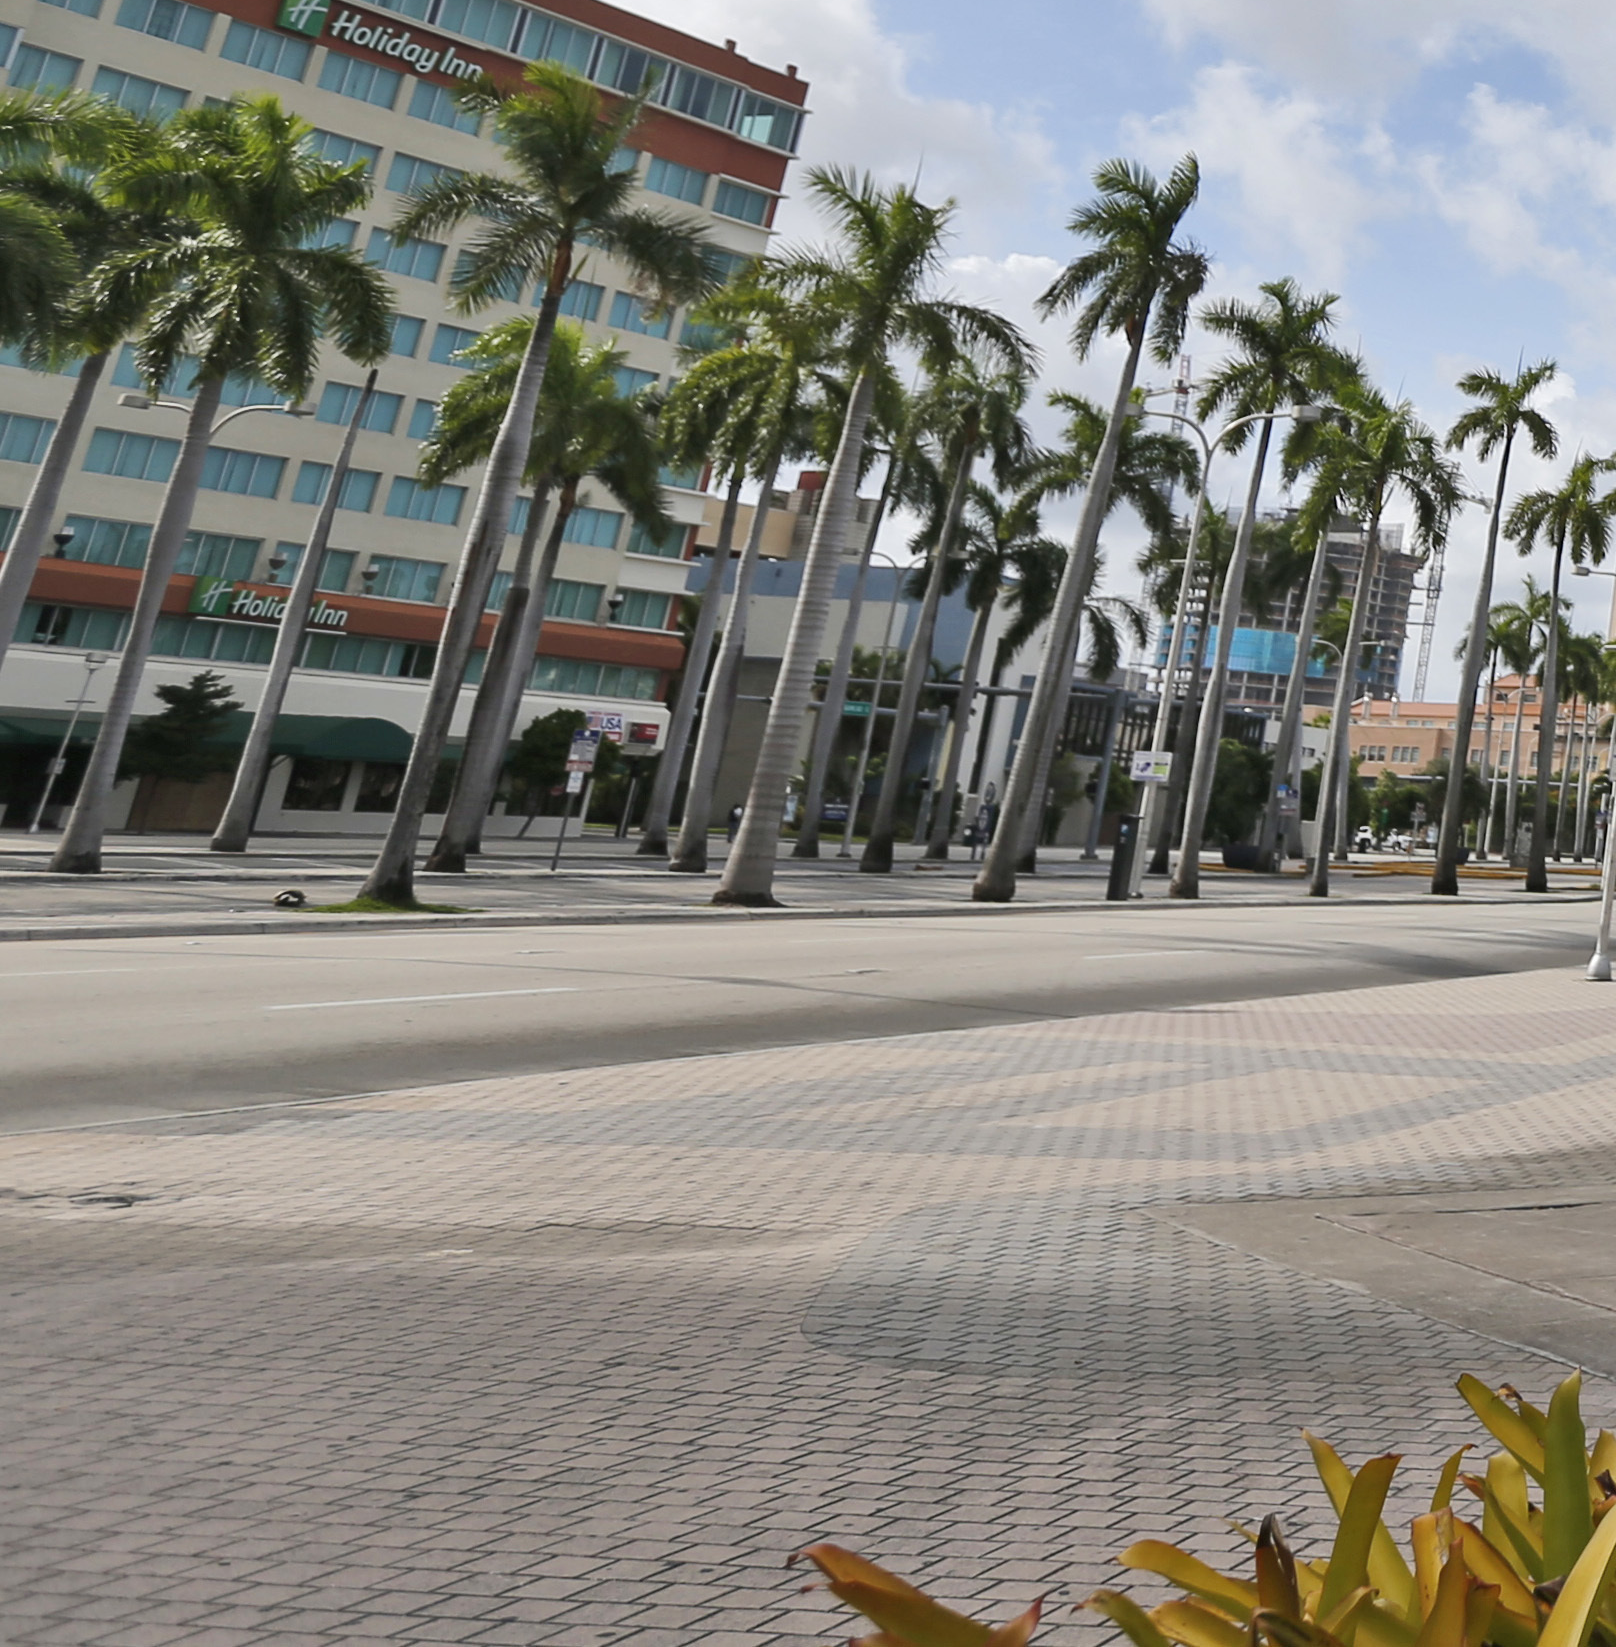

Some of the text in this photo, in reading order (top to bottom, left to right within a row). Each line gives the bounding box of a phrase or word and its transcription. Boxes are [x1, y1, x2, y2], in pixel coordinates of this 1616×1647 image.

[331, 9, 439, 74] Holiday
[439, 46, 484, 81] Inn
[313, 599, 349, 627] Inn
[600, 716, 622, 731] USA
